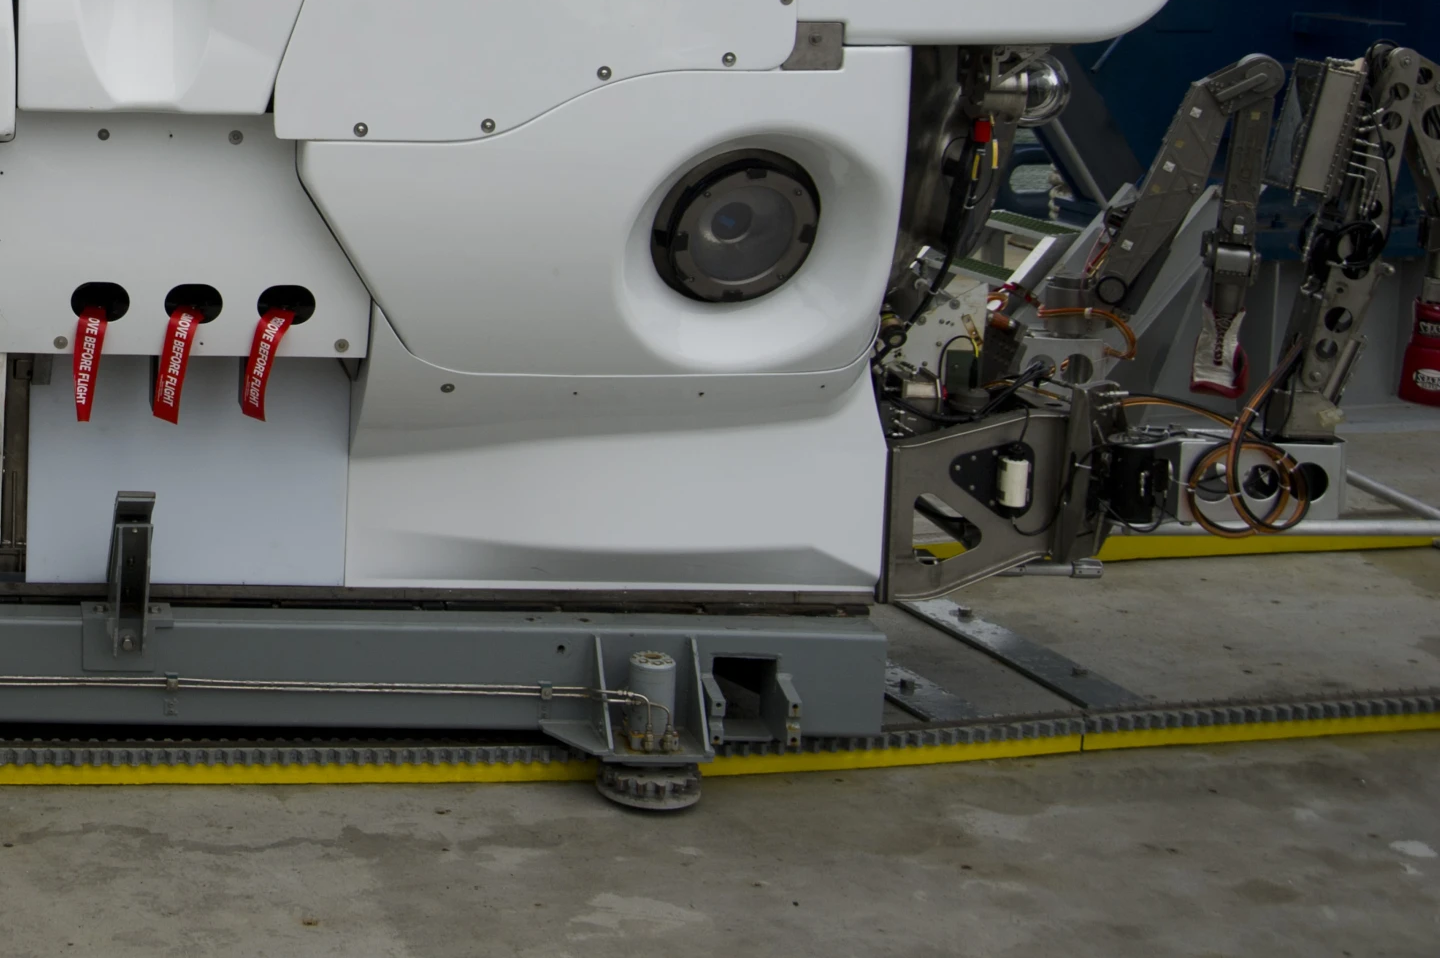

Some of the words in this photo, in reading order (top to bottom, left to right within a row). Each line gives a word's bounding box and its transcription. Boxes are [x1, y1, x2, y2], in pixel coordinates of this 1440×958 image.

[79, 335, 97, 372] BEFORE
[168, 339, 185, 376] BEFORE
[253, 341, 271, 379] BEFORE
[76, 372, 90, 405] FLIGHT
[163, 375, 178, 408] FLIGHT
[249, 376, 262, 408] FLIGHT
